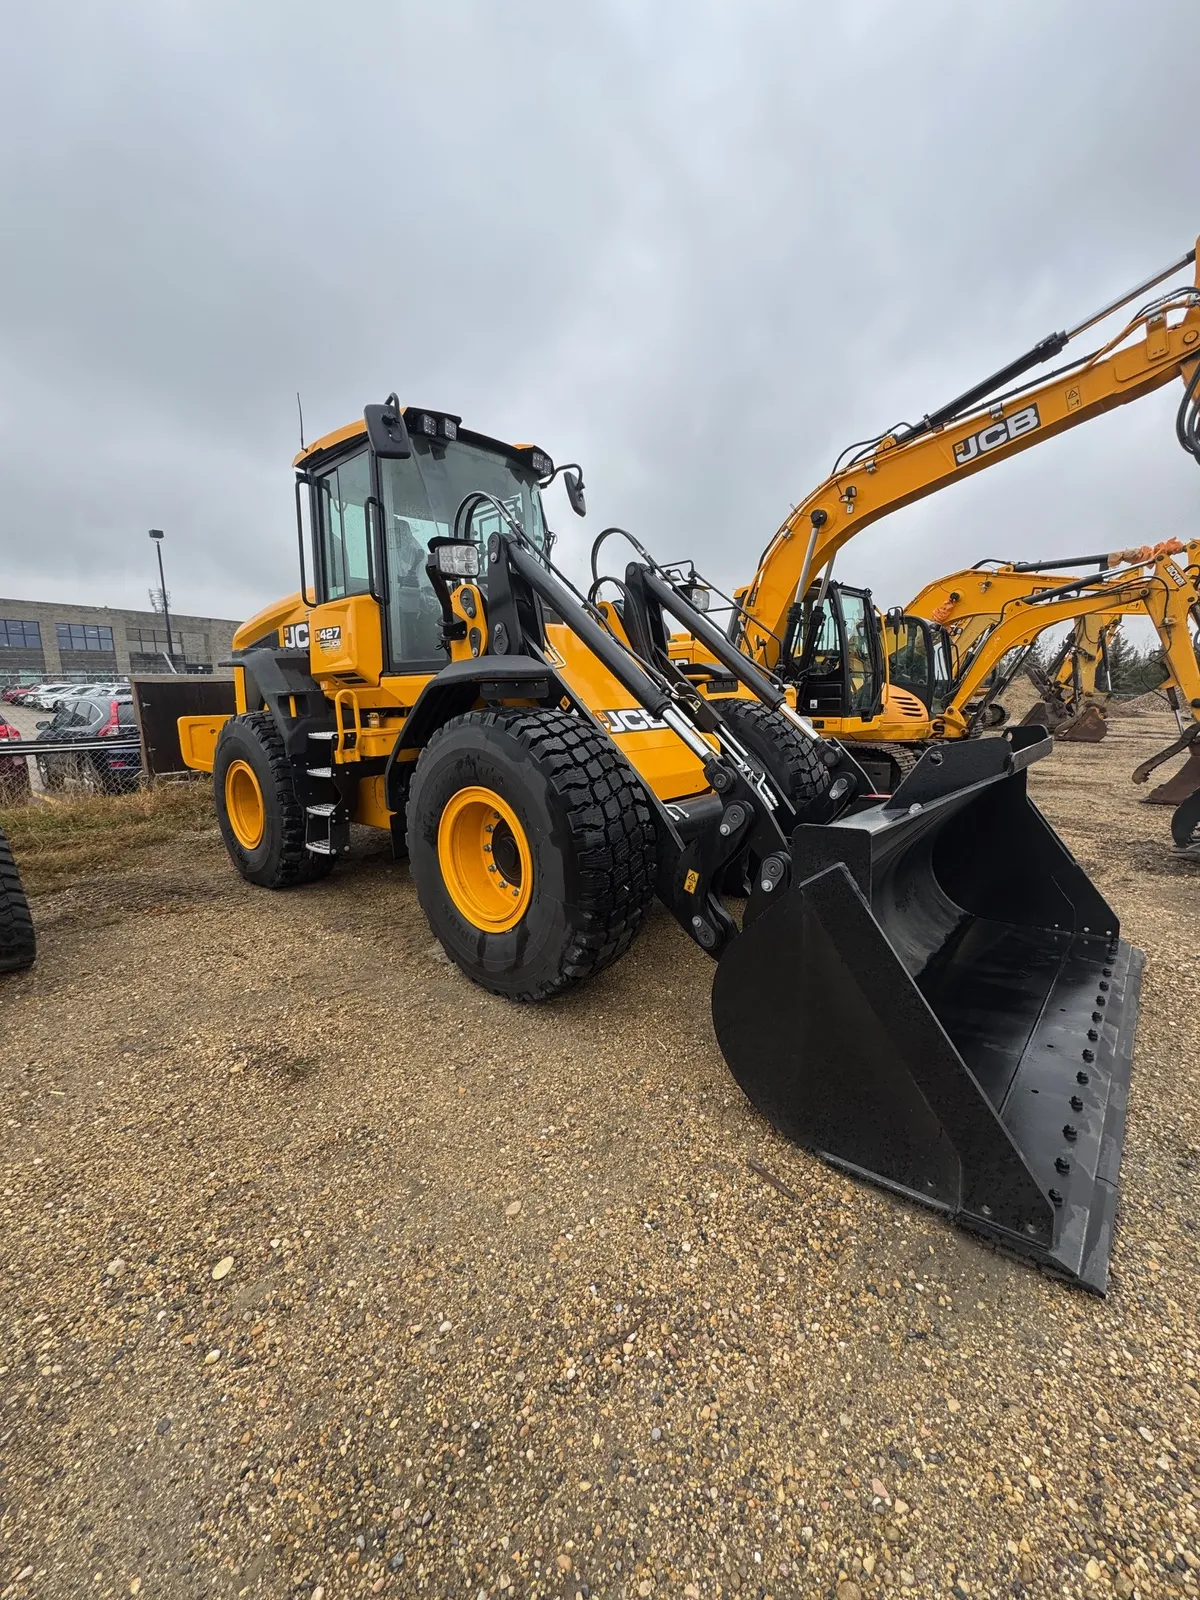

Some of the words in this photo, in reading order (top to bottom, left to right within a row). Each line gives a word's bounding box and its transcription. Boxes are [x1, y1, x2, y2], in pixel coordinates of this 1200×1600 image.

[956, 407, 1038, 463] JCB
[285, 623, 310, 648] JC
[320, 627, 340, 640] 427
